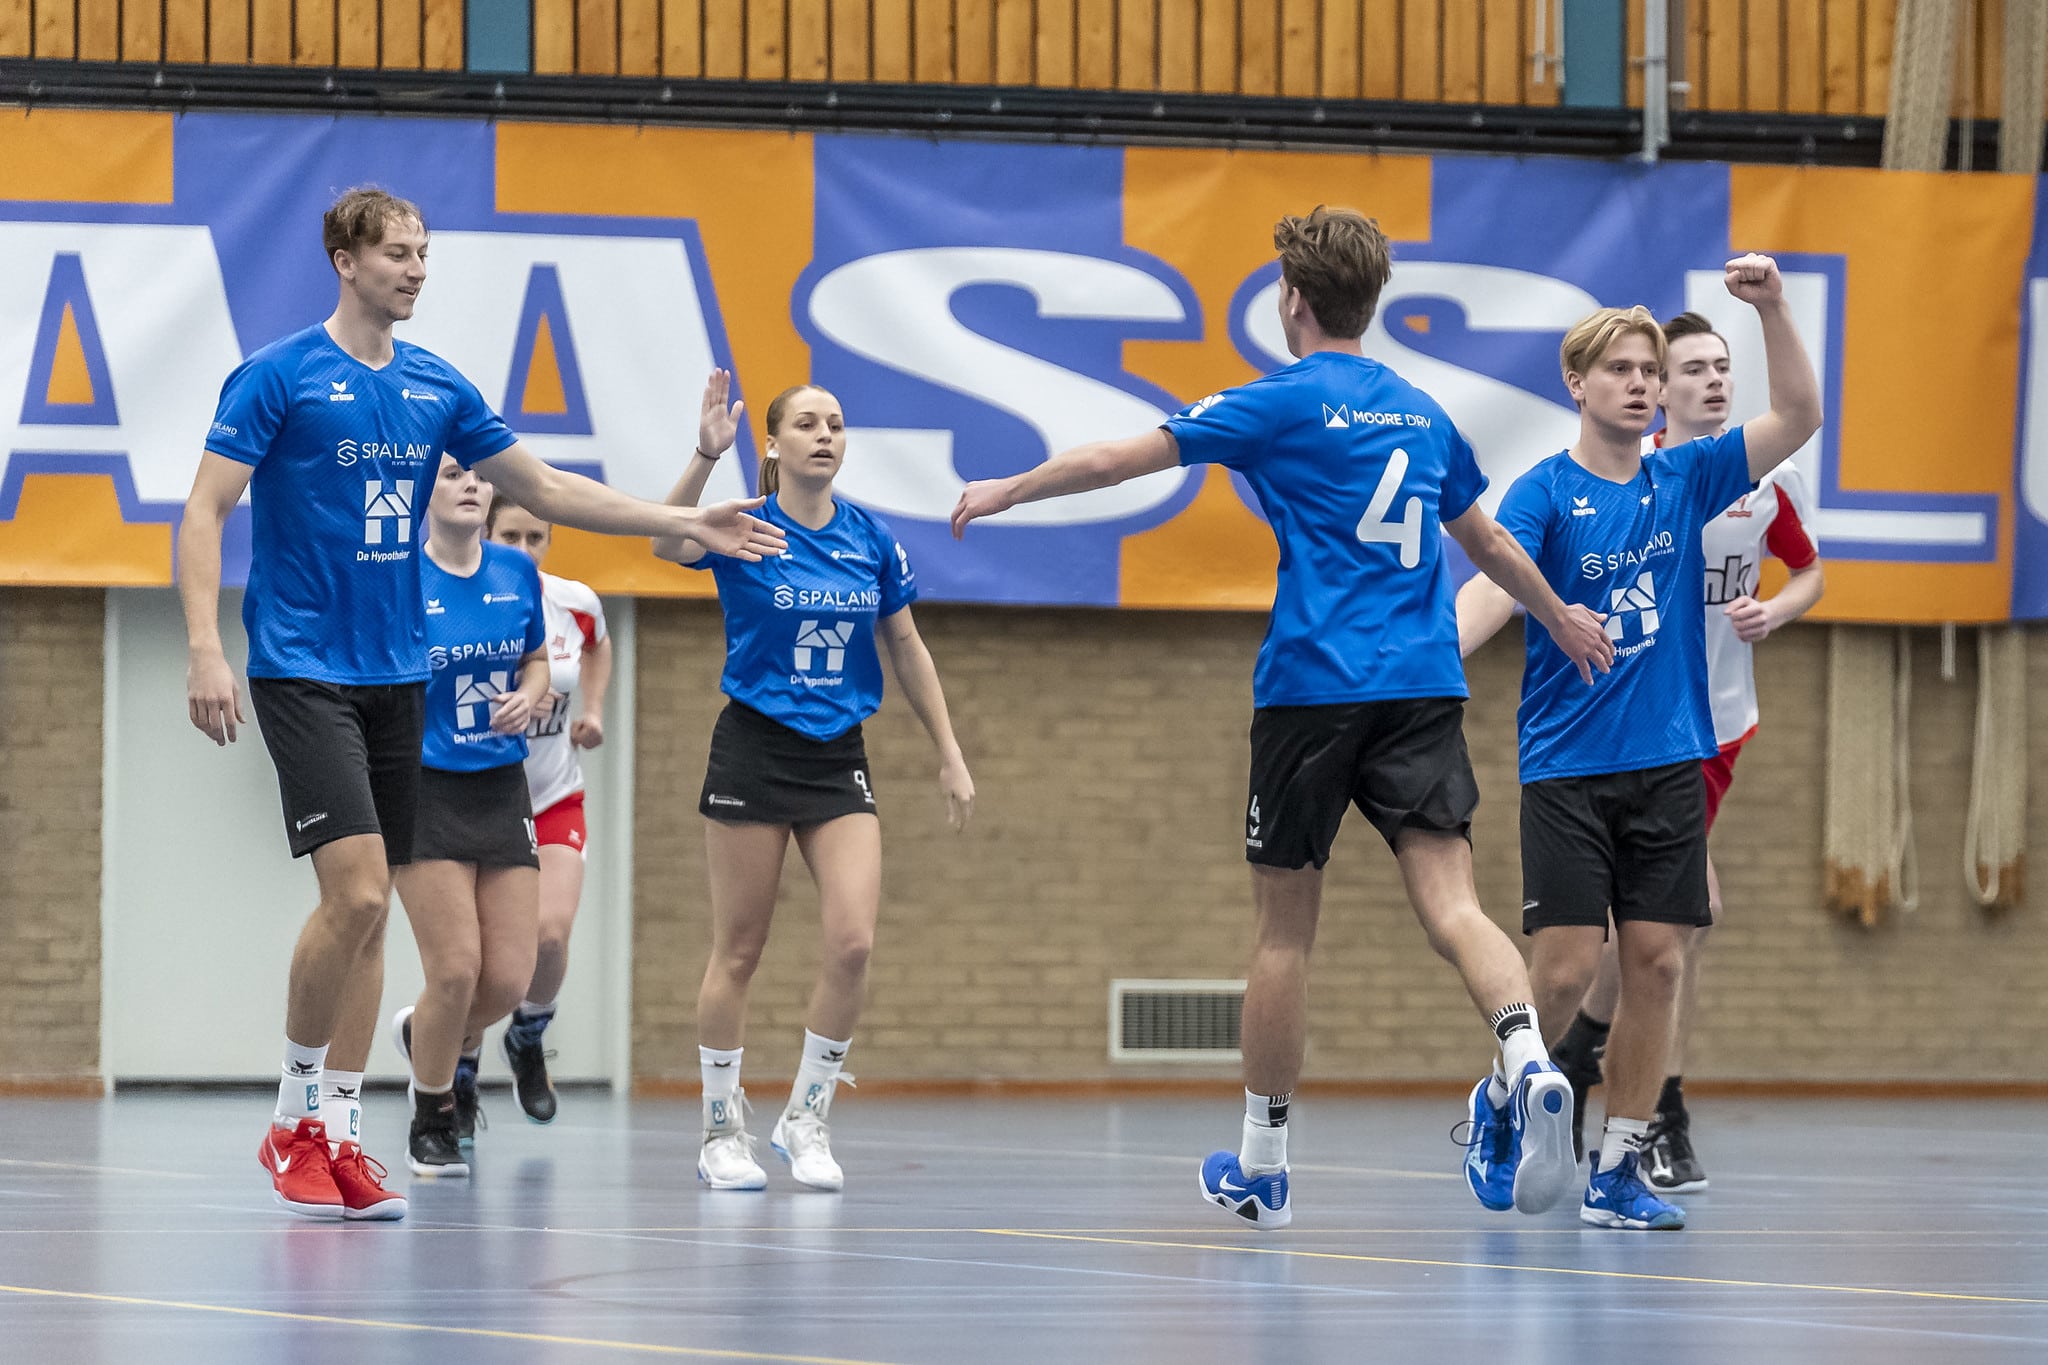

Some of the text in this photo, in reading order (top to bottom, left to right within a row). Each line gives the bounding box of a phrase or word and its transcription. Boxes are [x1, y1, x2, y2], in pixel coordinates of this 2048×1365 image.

[0, 220, 2048, 548] AASSL
[1352, 410, 1431, 429] MOORE DRV
[362, 442, 431, 460] SPALAND
[1356, 447, 1422, 569] 4
[356, 551, 370, 561] De
[798, 589, 882, 607] SPALAND
[451, 637, 526, 662] SPALAND
[1249, 794, 1261, 824] 4
